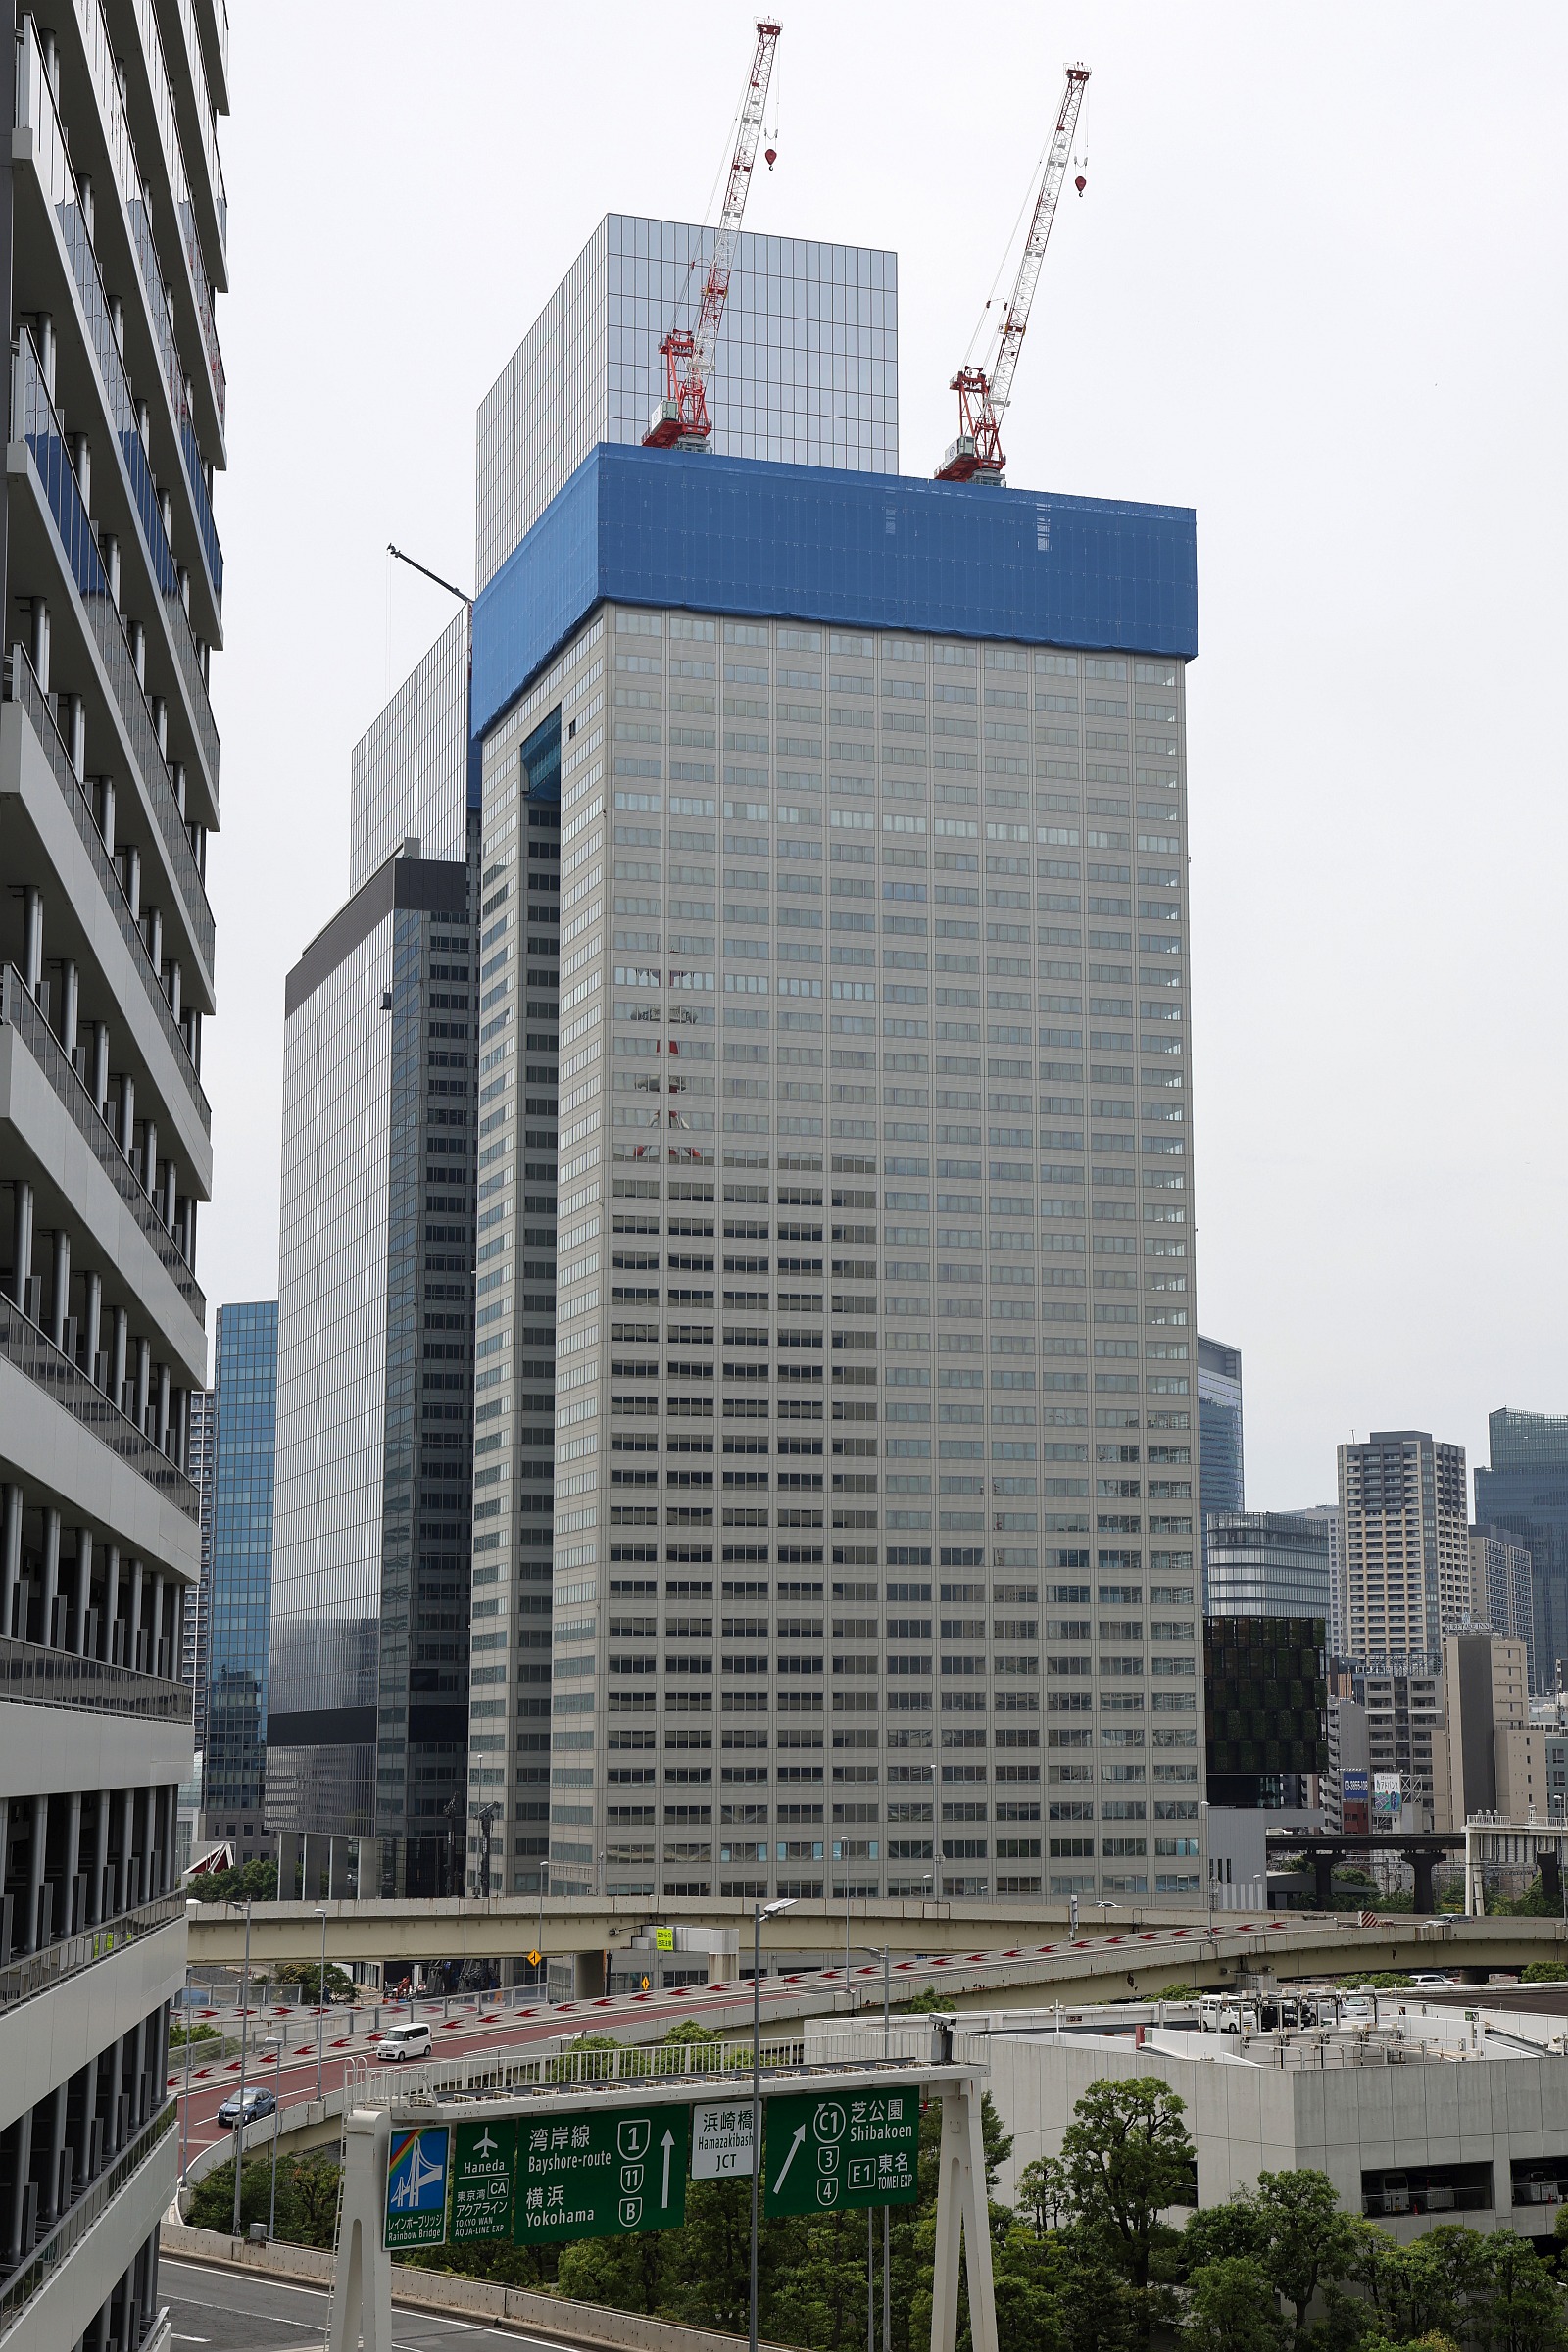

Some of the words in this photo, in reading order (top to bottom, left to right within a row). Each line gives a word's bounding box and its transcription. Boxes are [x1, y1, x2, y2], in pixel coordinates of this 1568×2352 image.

[703, 2109, 754, 2132] 浜崎橋
[851, 2099, 903, 2124] 芝公園
[528, 2124, 590, 2152] 湾岸線
[627, 2127, 640, 2151] 1
[698, 2132, 756, 2151] Hamazakibash
[850, 2123, 912, 2142] Shibakoen
[464, 2158, 505, 2174] Haneda
[528, 2150, 612, 2176] Bayshore-route
[715, 2153, 737, 2172] JCT
[825, 2150, 833, 2168] 3
[878, 2152, 908, 2174] 東名
[625, 2169, 639, 2187] 11
[853, 2164, 870, 2183] E1
[878, 2175, 899, 2190] TOMEI
[900, 2174, 913, 2188] EXP
[457, 2188, 486, 2202] 東京湾
[490, 2181, 506, 2195] CA
[526, 2184, 564, 2210] 横浜
[823, 2182, 832, 2199] 4
[456, 2201, 508, 2218] アクアライン
[525, 2208, 595, 2228] Yokohama
[626, 2202, 636, 2221] B
[388, 2214, 443, 2231] レインボーブリッジ
[455, 2226, 490, 2237] AQUA-LINE
[492, 2224, 505, 2233] EXP
[456, 2218, 476, 2228] TOKYO
[478, 2216, 493, 2225] WAN
[388, 2230, 417, 2242] Rainbow
[418, 2228, 441, 2239] Bridge
